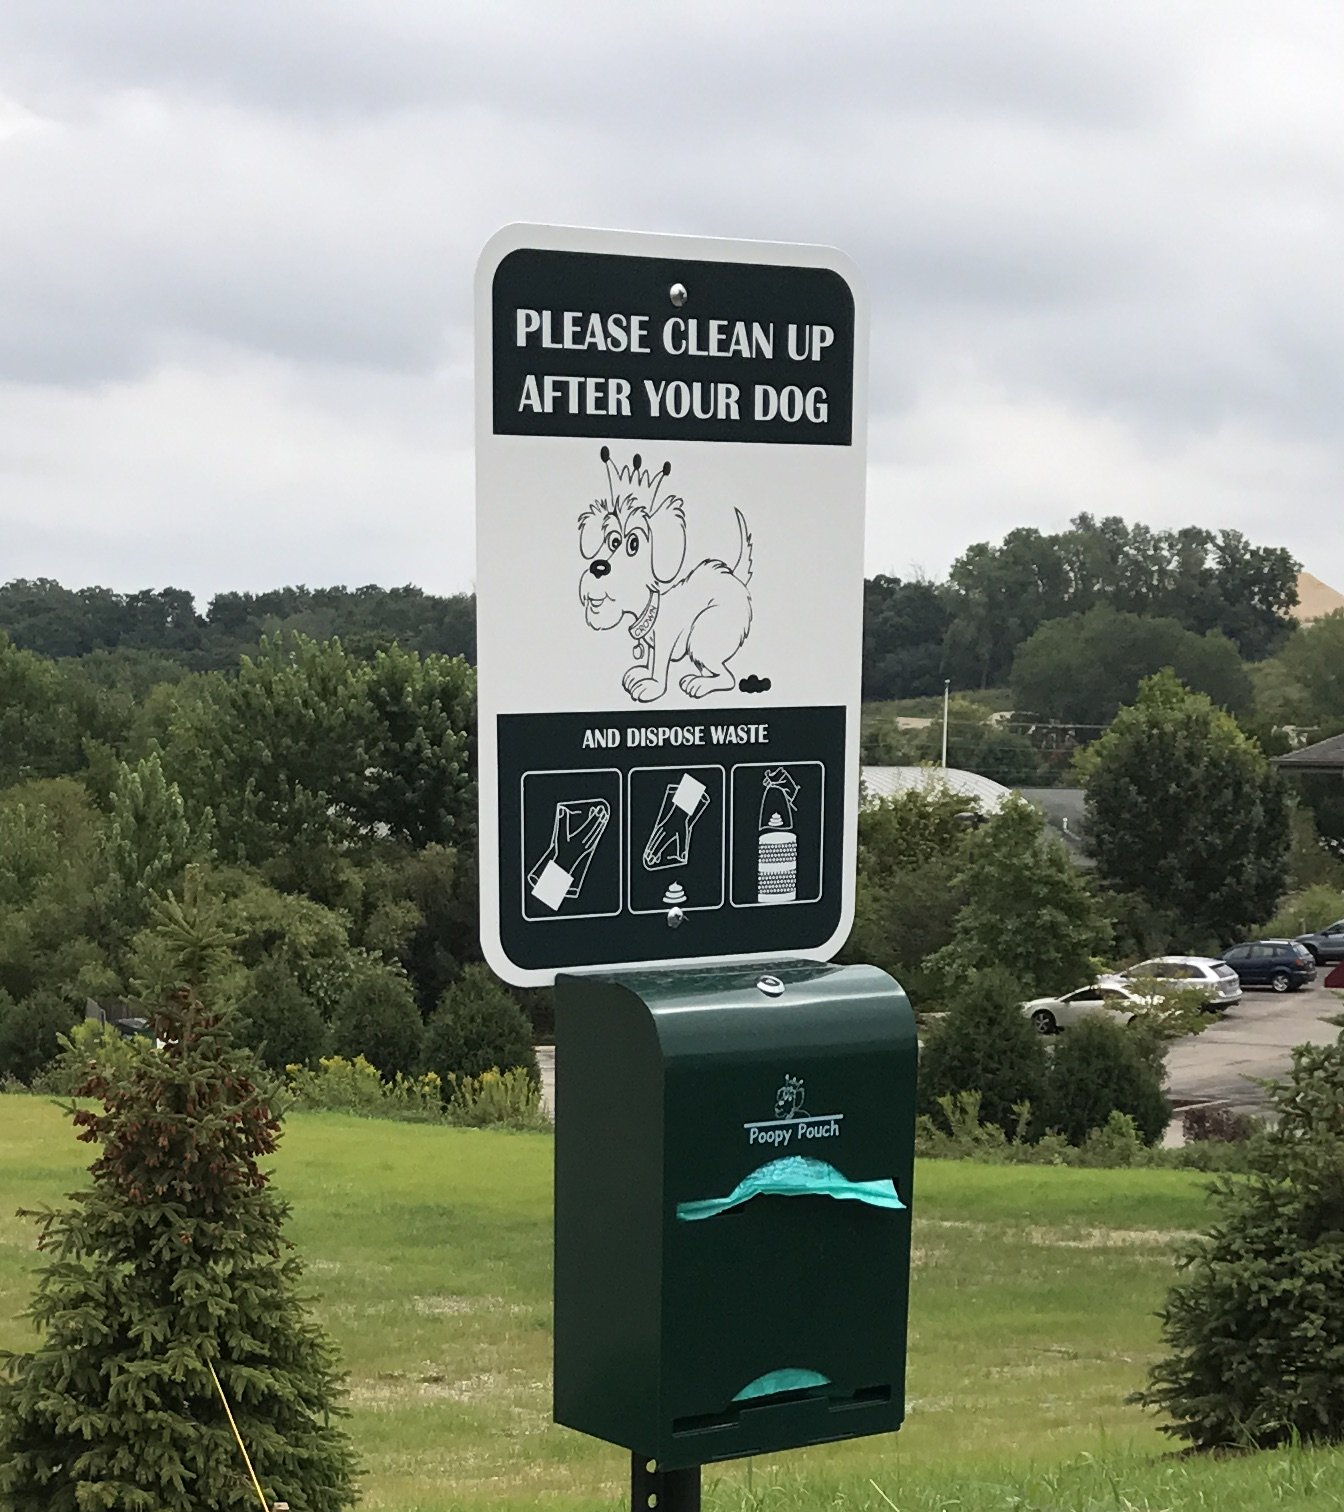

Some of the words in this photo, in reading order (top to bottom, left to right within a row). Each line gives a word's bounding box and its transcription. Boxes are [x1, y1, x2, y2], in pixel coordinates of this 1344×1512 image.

[516, 308, 651, 354] PLEASE
[662, 317, 774, 359] CLEAN
[787, 323, 835, 362] UP
[518, 374, 632, 416] AFTER
[643, 379, 741, 420] YOUR
[754, 384, 828, 424] DOG
[582, 728, 621, 749] AND
[626, 725, 706, 748] DISPOSE
[709, 723, 769, 745] WASTE
[749, 1127, 793, 1147] Poopy
[797, 1119, 840, 1139] Pouch
